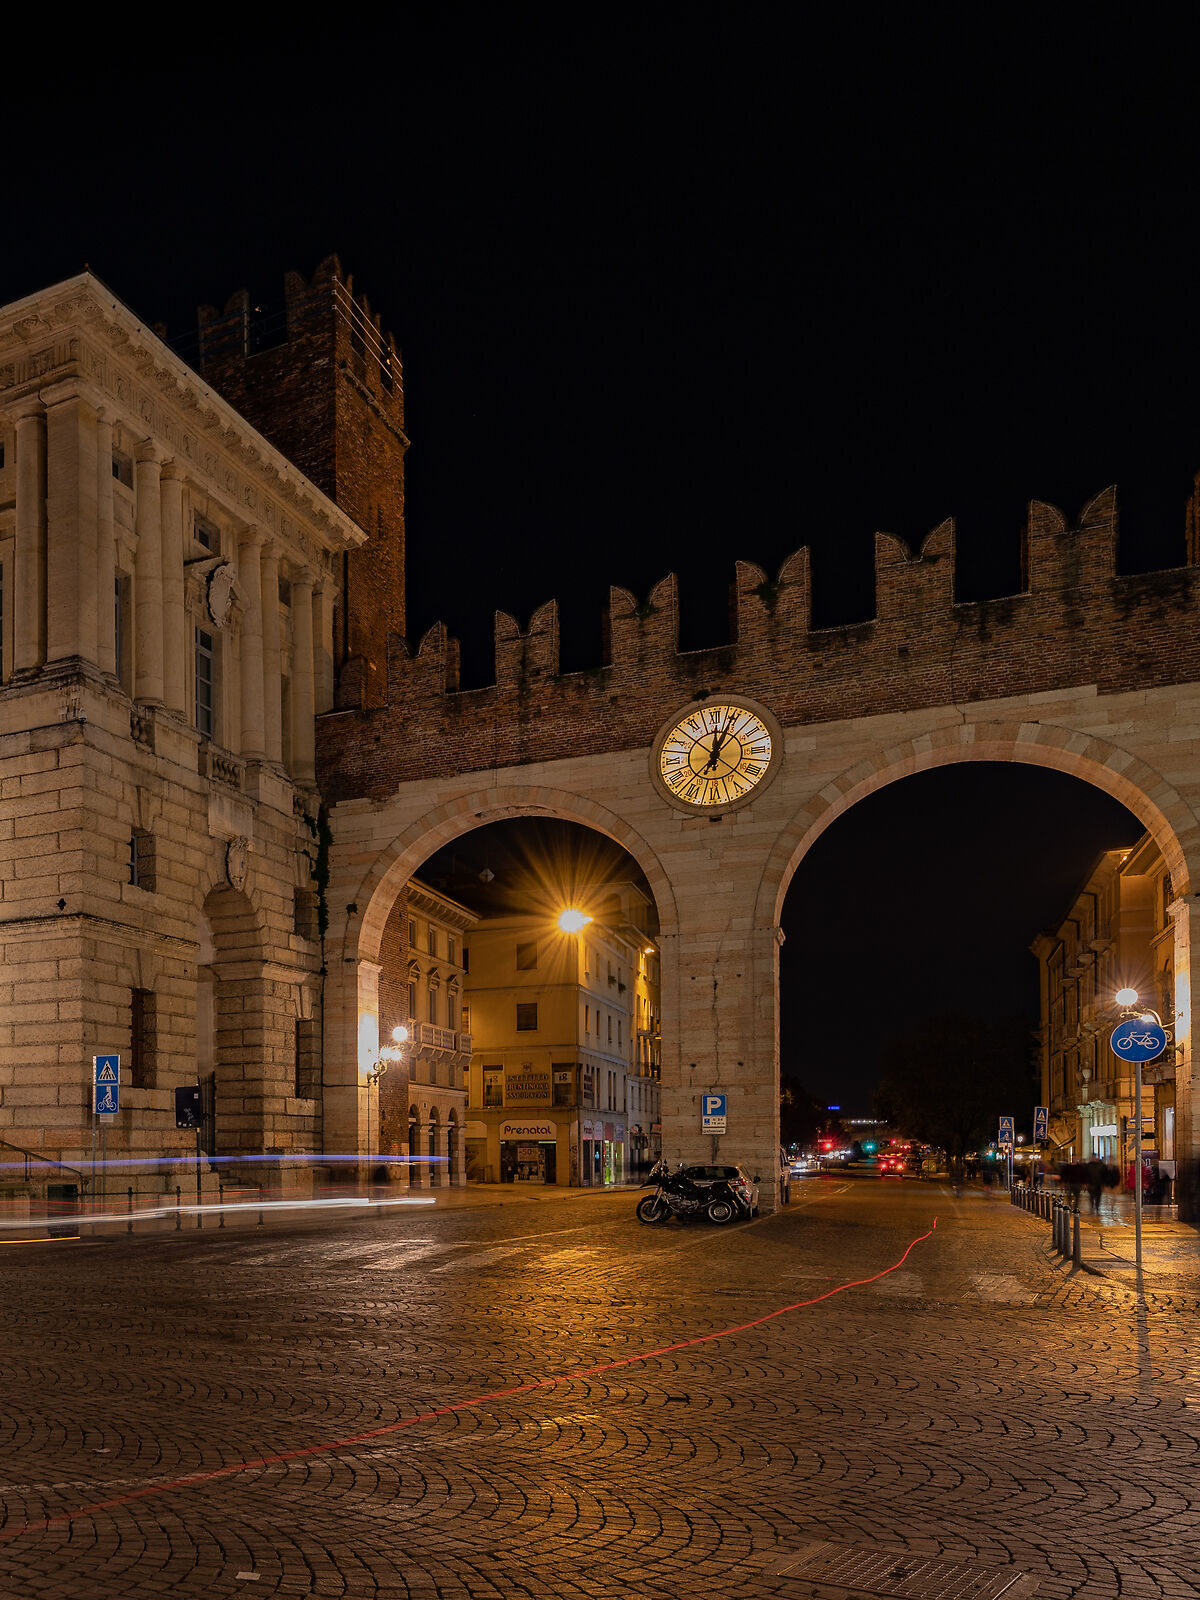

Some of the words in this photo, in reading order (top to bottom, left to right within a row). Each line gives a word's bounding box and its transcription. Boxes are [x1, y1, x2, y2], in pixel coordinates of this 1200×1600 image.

[709, 710, 721, 725] XII
[687, 719, 701, 733] XI
[751, 746, 766, 756] III
[683, 770, 693, 778] 20
[727, 774, 735, 783] 17
[696, 778, 704, 787] 19
[706, 1096, 722, 1115] P
[504, 1125, 552, 1135] Prenatal
